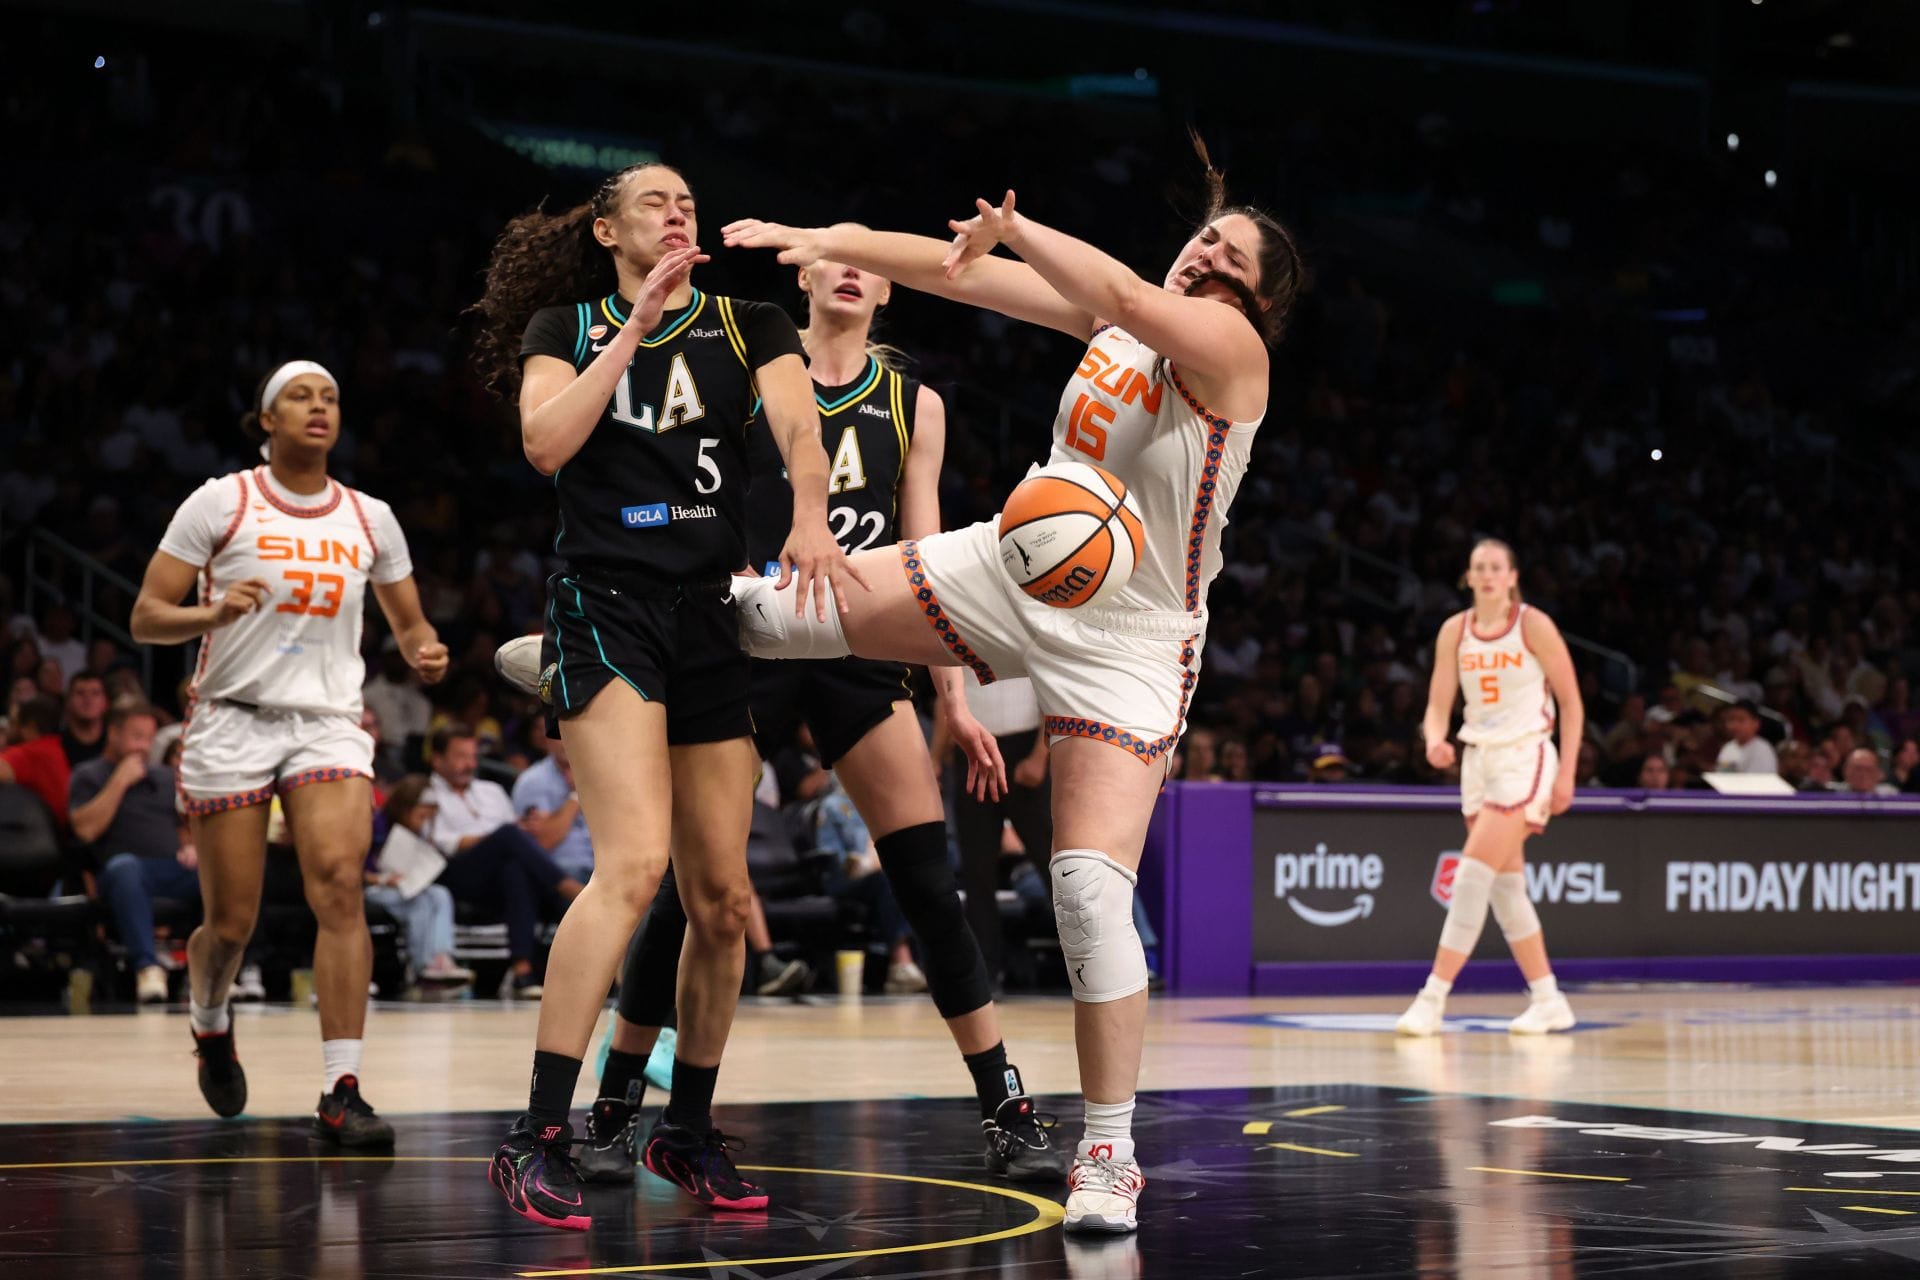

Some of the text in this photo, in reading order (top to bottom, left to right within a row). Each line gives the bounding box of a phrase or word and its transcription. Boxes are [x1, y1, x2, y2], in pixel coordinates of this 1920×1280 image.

[687, 328, 725, 338] Albert
[610, 351, 705, 434] LA
[1076, 347, 1163, 416] SUN
[858, 404, 890, 419] Albert
[1065, 393, 1117, 462] 15
[695, 438, 722, 494] 5
[627, 504, 717, 524] UCLA Health
[829, 507, 886, 556] 22
[257, 535, 360, 569] SUN
[276, 571, 345, 619] 33
[1462, 652, 1522, 671] SUN
[1480, 675, 1500, 704] 5
[1274, 843, 1383, 898] prime
[1524, 862, 1622, 904] WSL
[1666, 861, 1920, 912] FRIDAY NIGHT
